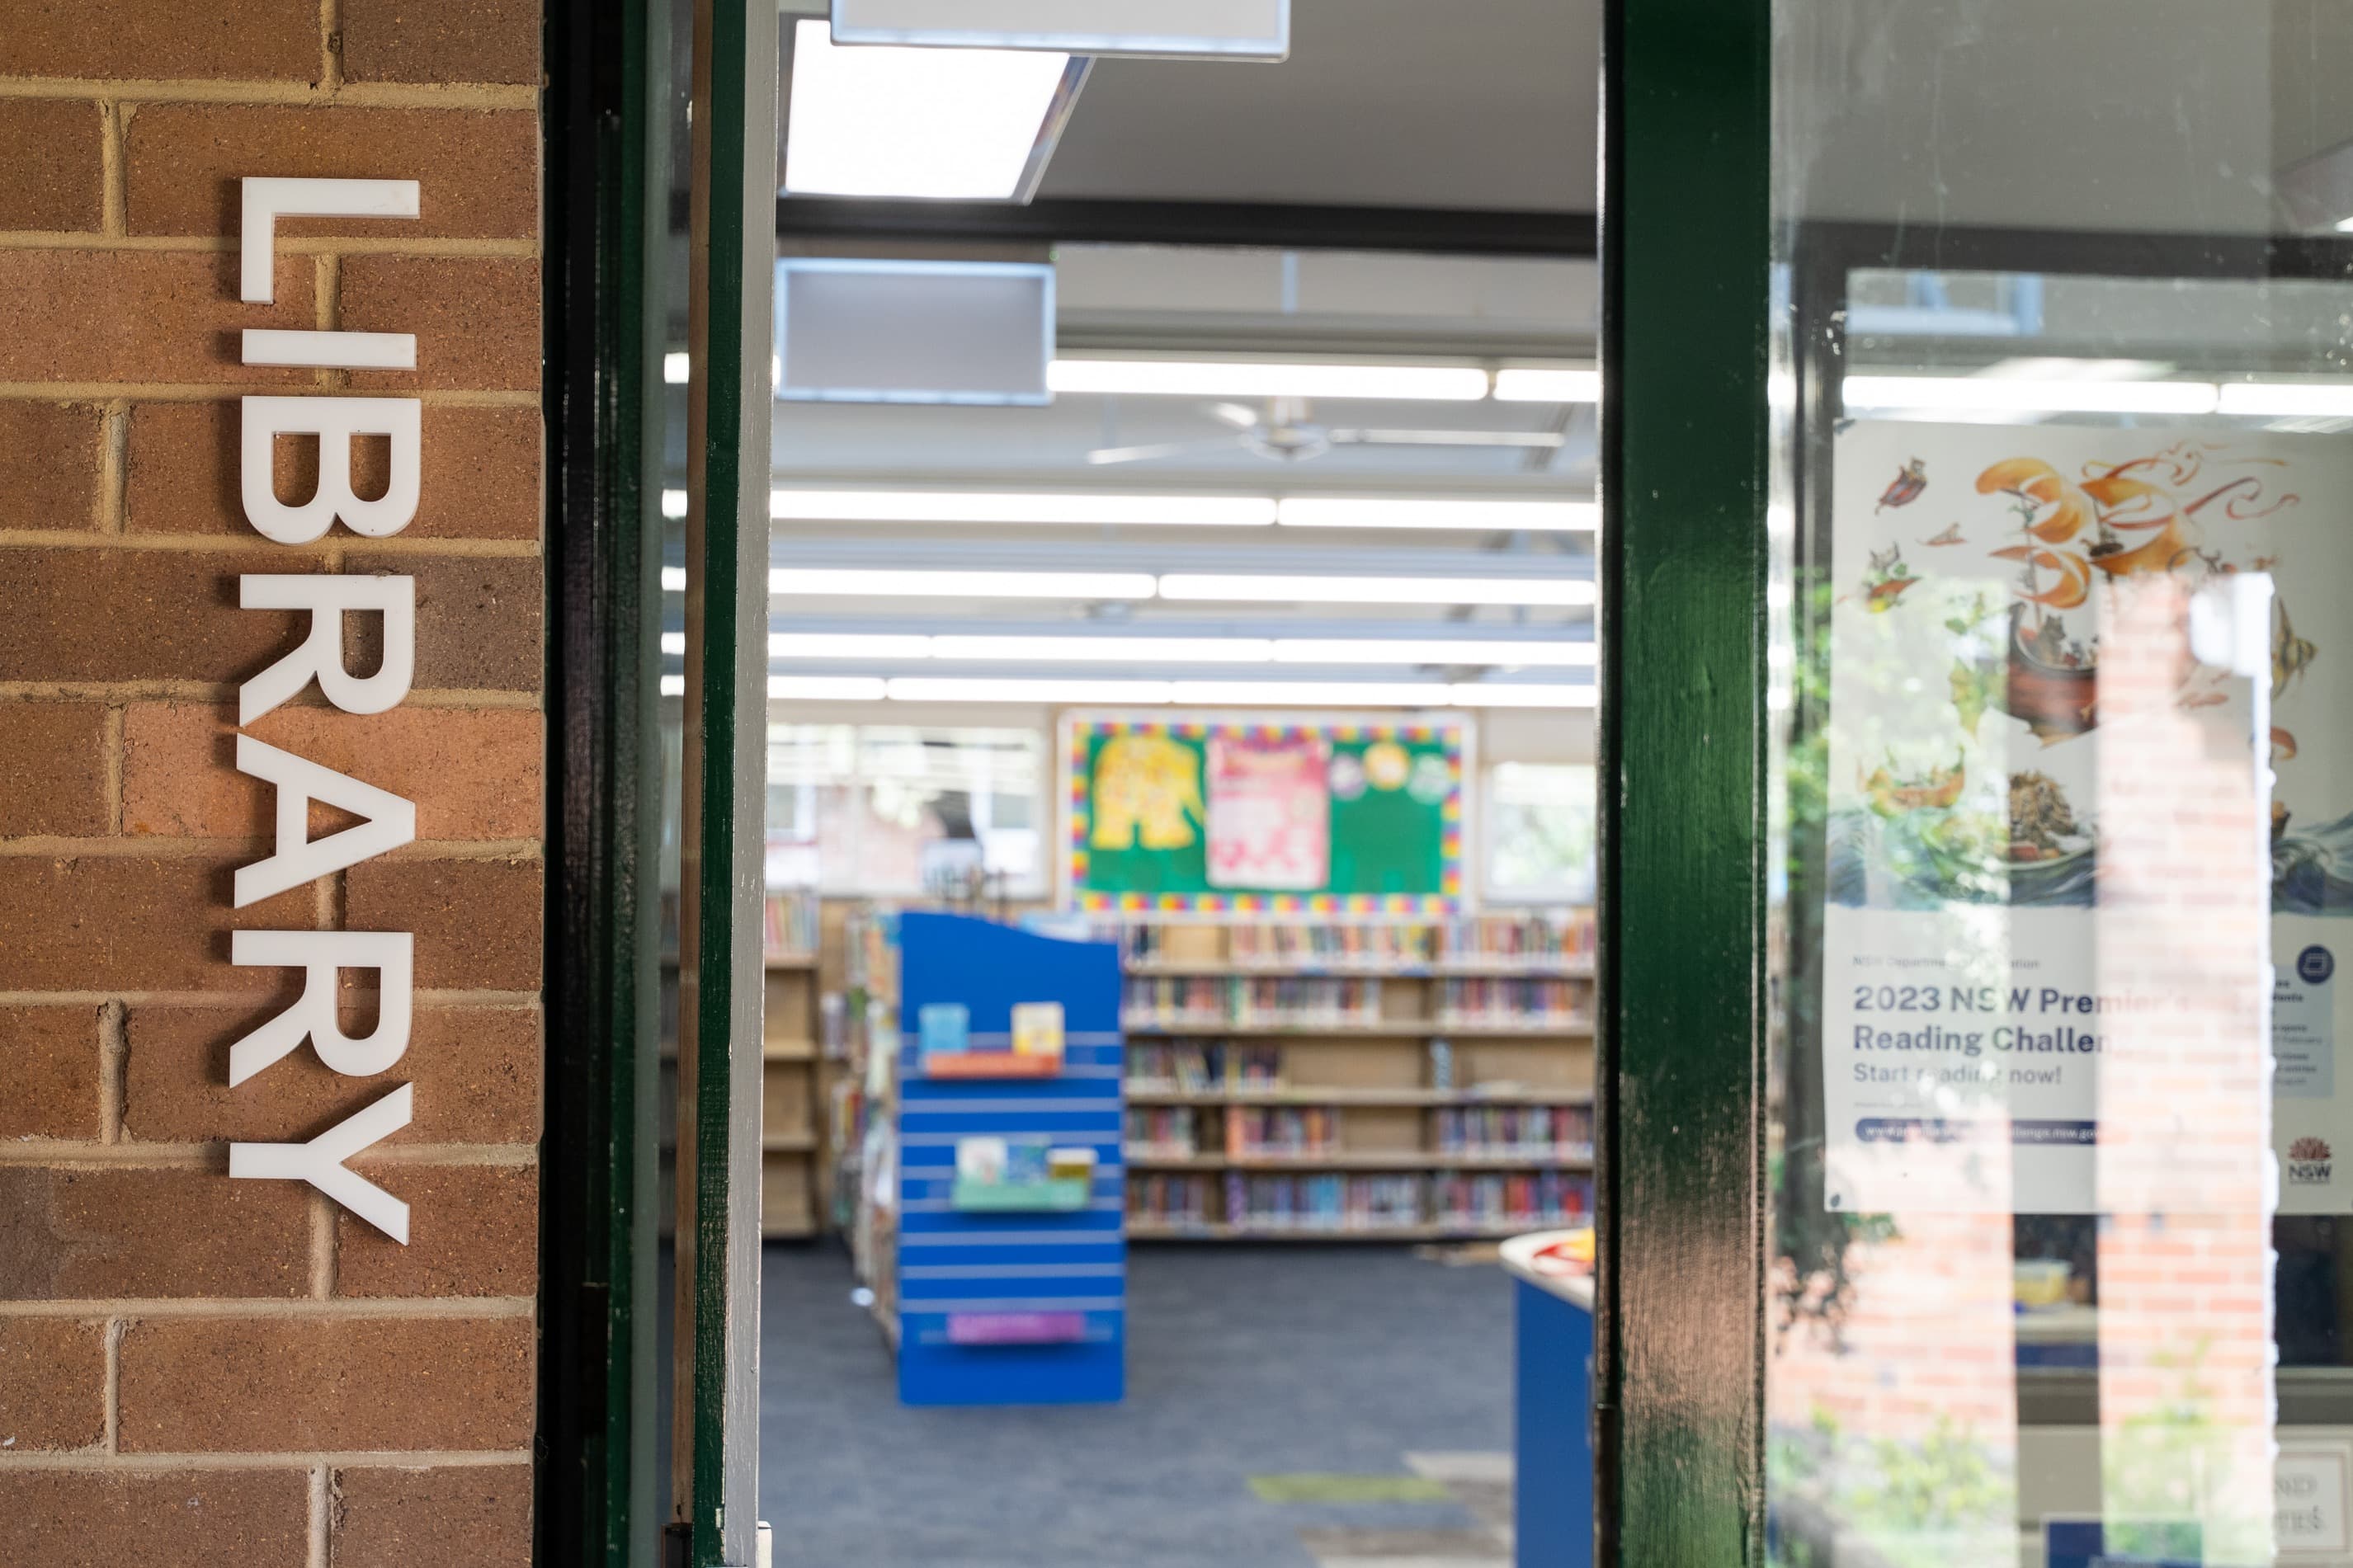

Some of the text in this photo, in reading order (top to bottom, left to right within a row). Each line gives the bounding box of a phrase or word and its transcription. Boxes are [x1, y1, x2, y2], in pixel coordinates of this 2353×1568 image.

[229, 177, 420, 1246] LIBRARY
[1854, 986, 1940, 1012] 2023
[1950, 986, 2030, 1013] NSW
[1853, 1024, 2113, 1057] Reading Challen
[1853, 1063, 1911, 1083] Start
[2008, 1065, 2062, 1085] now!
[2288, 1162, 2332, 1180] NSW
